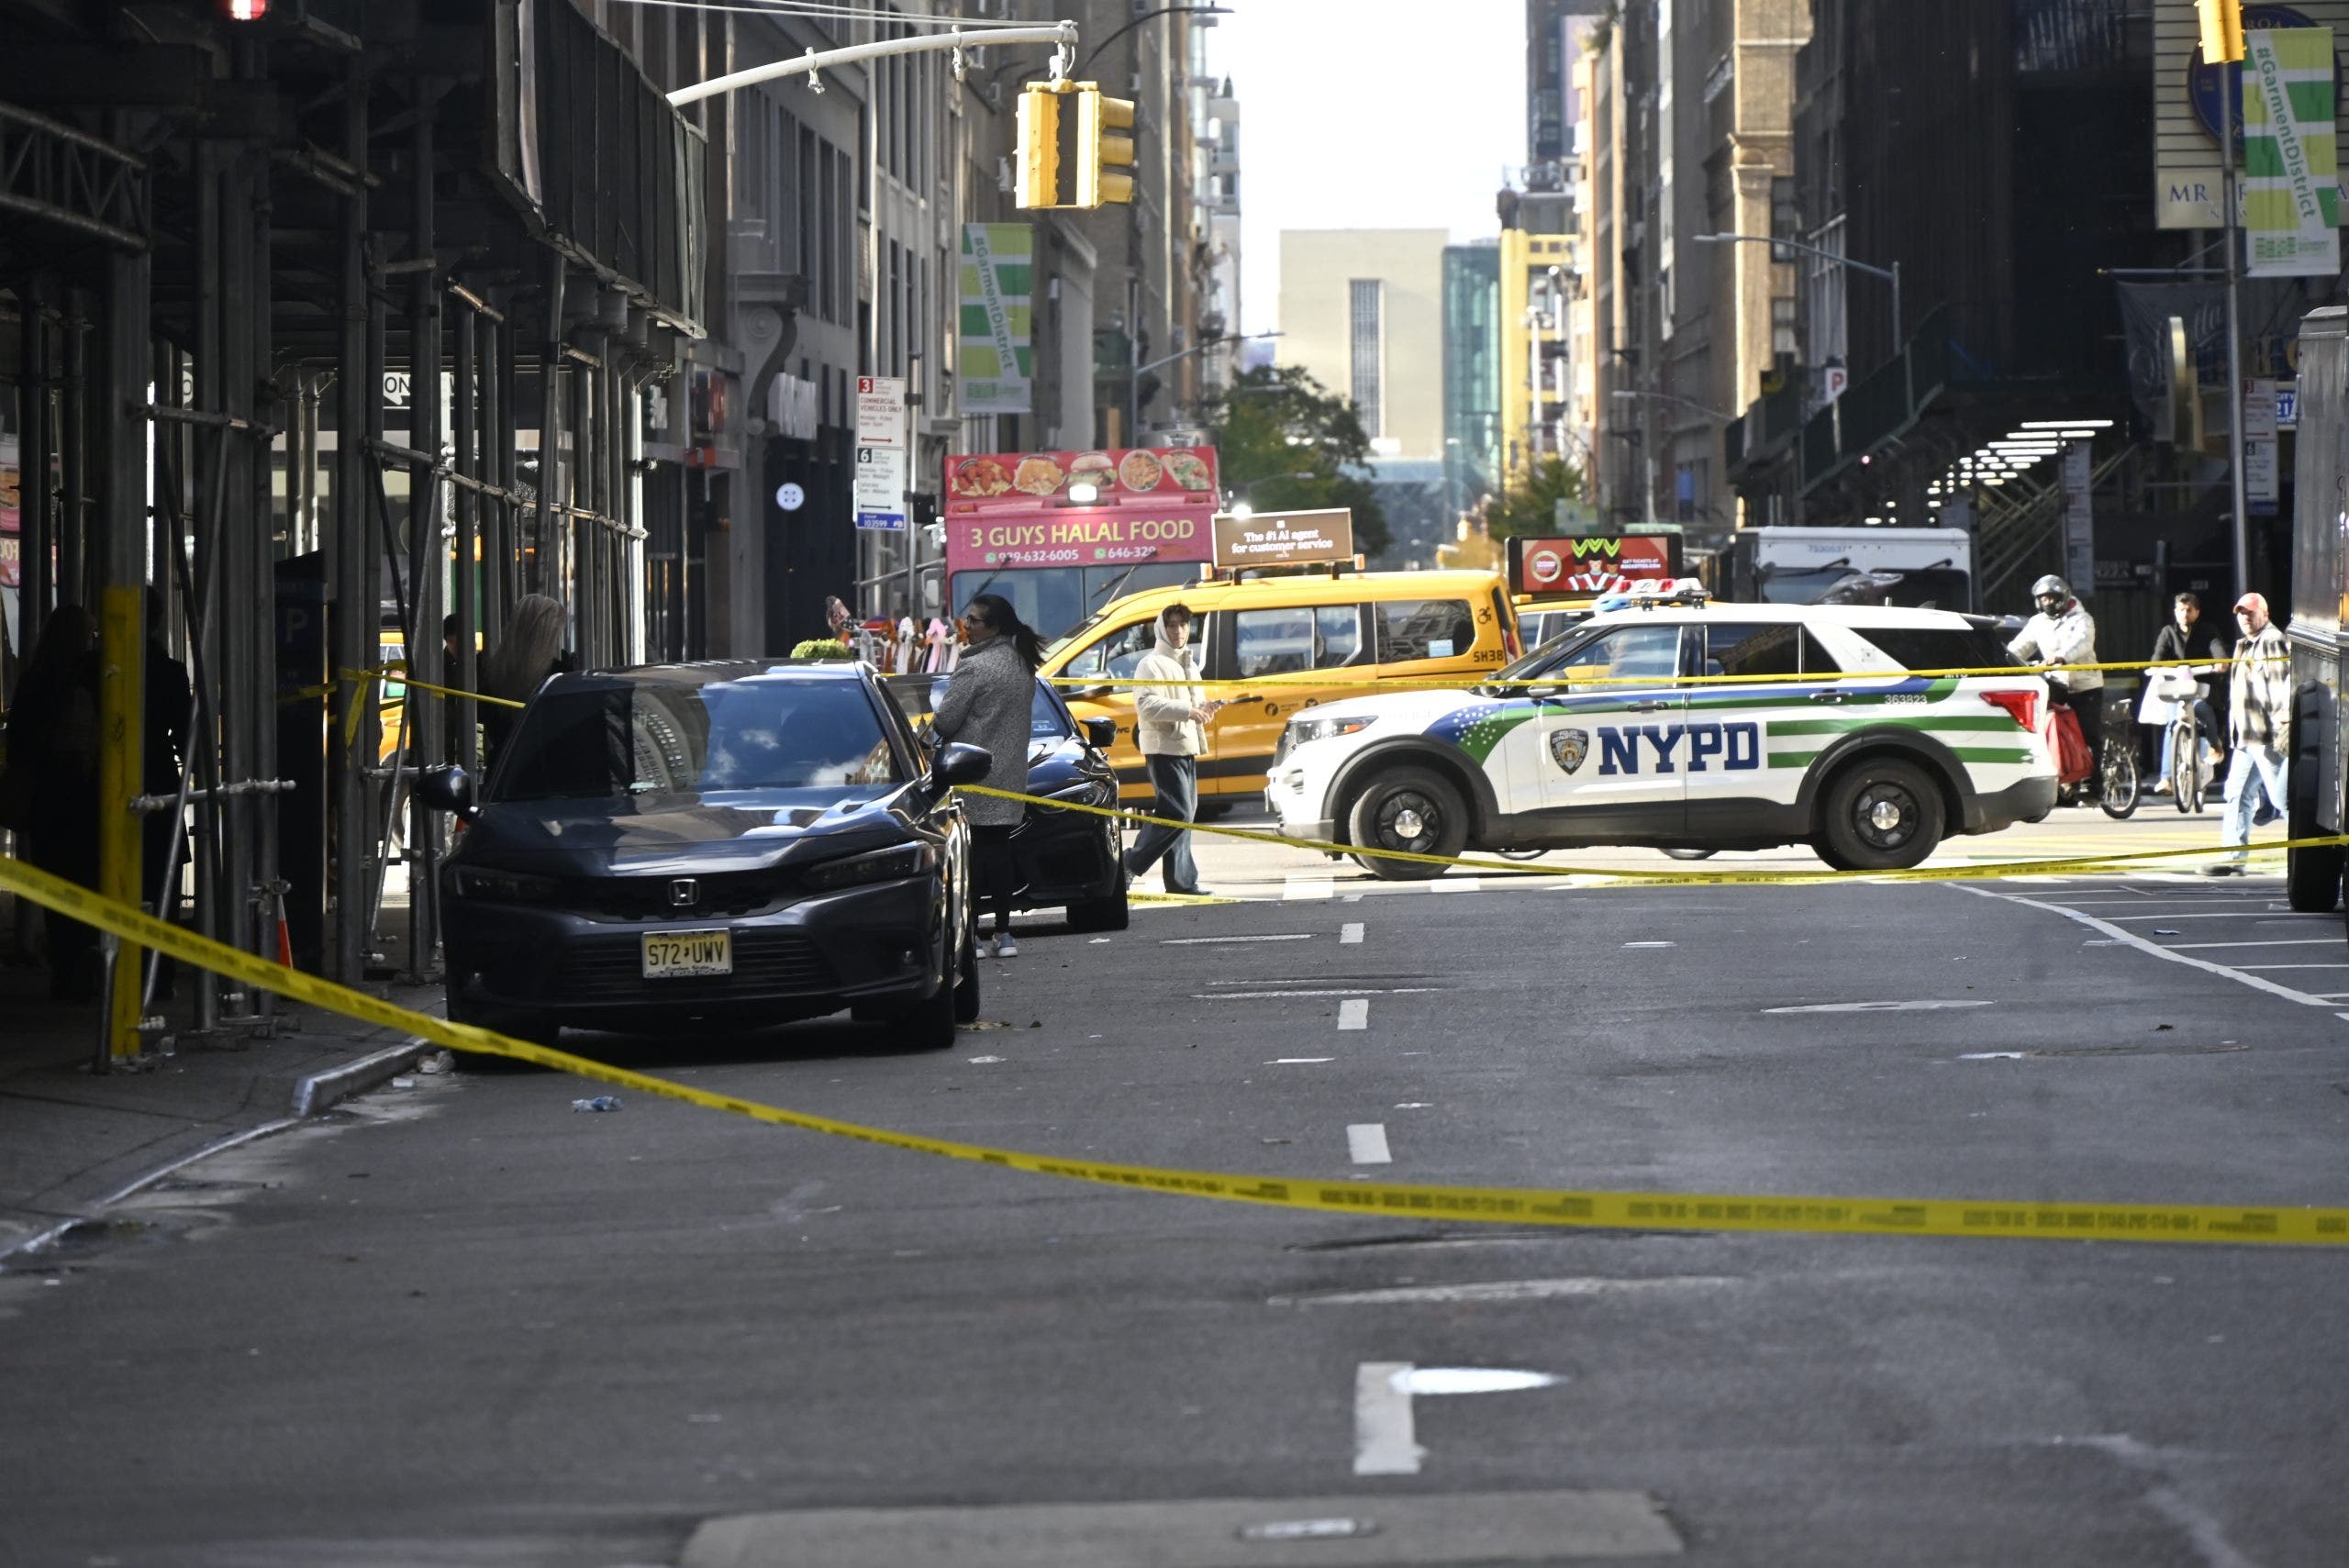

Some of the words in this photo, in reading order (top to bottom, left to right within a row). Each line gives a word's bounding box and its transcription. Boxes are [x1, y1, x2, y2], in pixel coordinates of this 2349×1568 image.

[2256, 47, 2315, 218] #GarmentDistrict
[2169, 183, 2209, 203] MR
[974, 237, 1013, 368] #GarmentDistrict
[385, 376, 410, 394] ON
[862, 379, 871, 393] 3
[1831, 372, 1844, 392] P
[861, 449, 870, 462] 6
[971, 528, 983, 548] 3
[988, 525, 1046, 548] GUYS
[1051, 521, 1123, 544] HALAL
[1130, 519, 1195, 540] FOOD
[1243, 532, 1264, 542] The
[1278, 529, 1289, 540] AI
[1291, 528, 1319, 539] agent
[1231, 543, 1248, 553] for
[1249, 541, 1297, 552] customer
[1297, 539, 1333, 550] service
[1597, 721, 1760, 775] NYPD
[649, 943, 681, 966] S72
[692, 940, 724, 963] UWV
